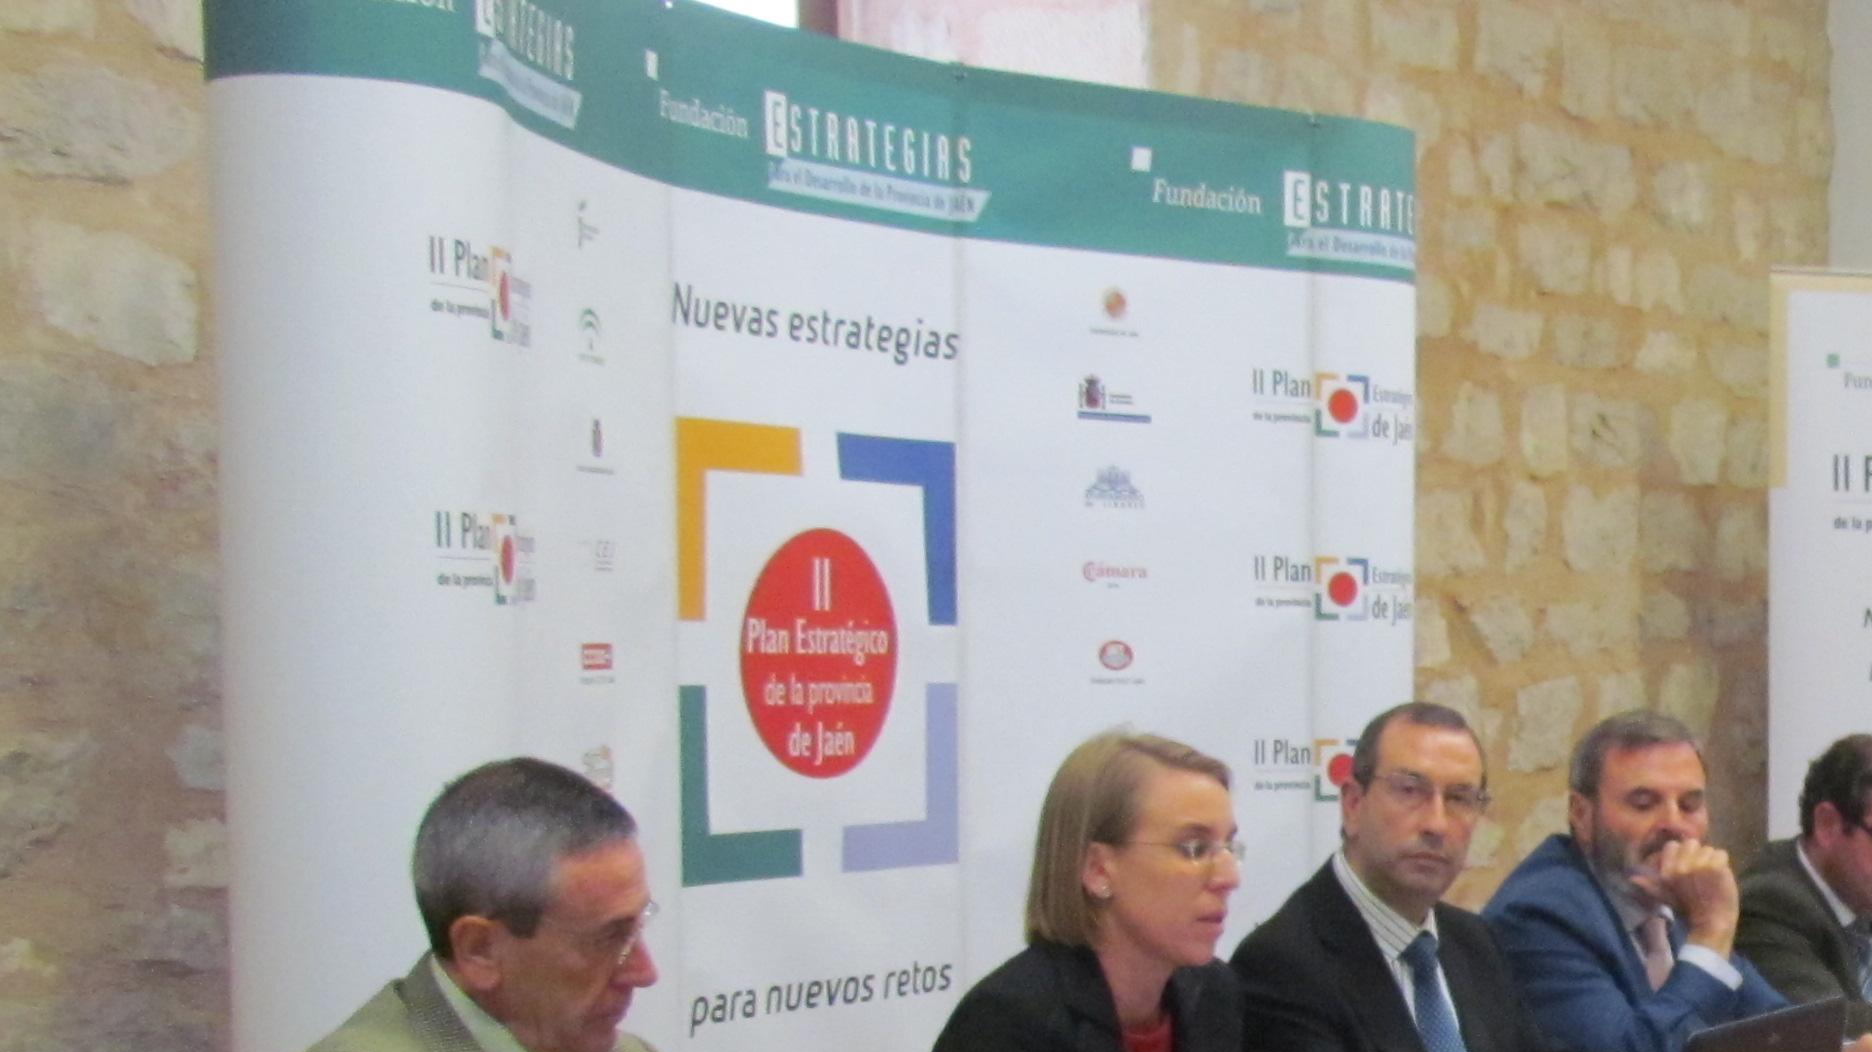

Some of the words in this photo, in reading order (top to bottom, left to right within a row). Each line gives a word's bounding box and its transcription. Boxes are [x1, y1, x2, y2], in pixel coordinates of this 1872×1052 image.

[660, 89, 748, 139] Fundación
[766, 91, 971, 184] ESTRATEGIAS
[1153, 179, 1261, 215] Fundación
[672, 282, 779, 337] Nuevas
[789, 310, 960, 365] estrategias
[1252, 368, 1265, 395] II
[1272, 370, 1312, 398] Plan
[1372, 413, 1389, 438] de
[1833, 454, 1849, 492] II
[1834, 516, 1847, 529] de
[813, 558, 831, 611] II
[1254, 556, 1266, 582] II
[1273, 556, 1312, 582] Plan
[1372, 594, 1388, 619] de
[747, 617, 789, 654] Plan
[796, 617, 888, 666] Estratégico
[765, 672, 786, 706] de
[791, 672, 804, 705] la
[808, 674, 874, 714] provincia
[788, 721, 811, 757] de
[814, 721, 855, 765] Jaén
[1254, 740, 1265, 765] II
[1273, 739, 1312, 765] Plan
[689, 988, 757, 1038] para
[766, 974, 876, 1015] nuevos
[884, 961, 953, 999] retos
